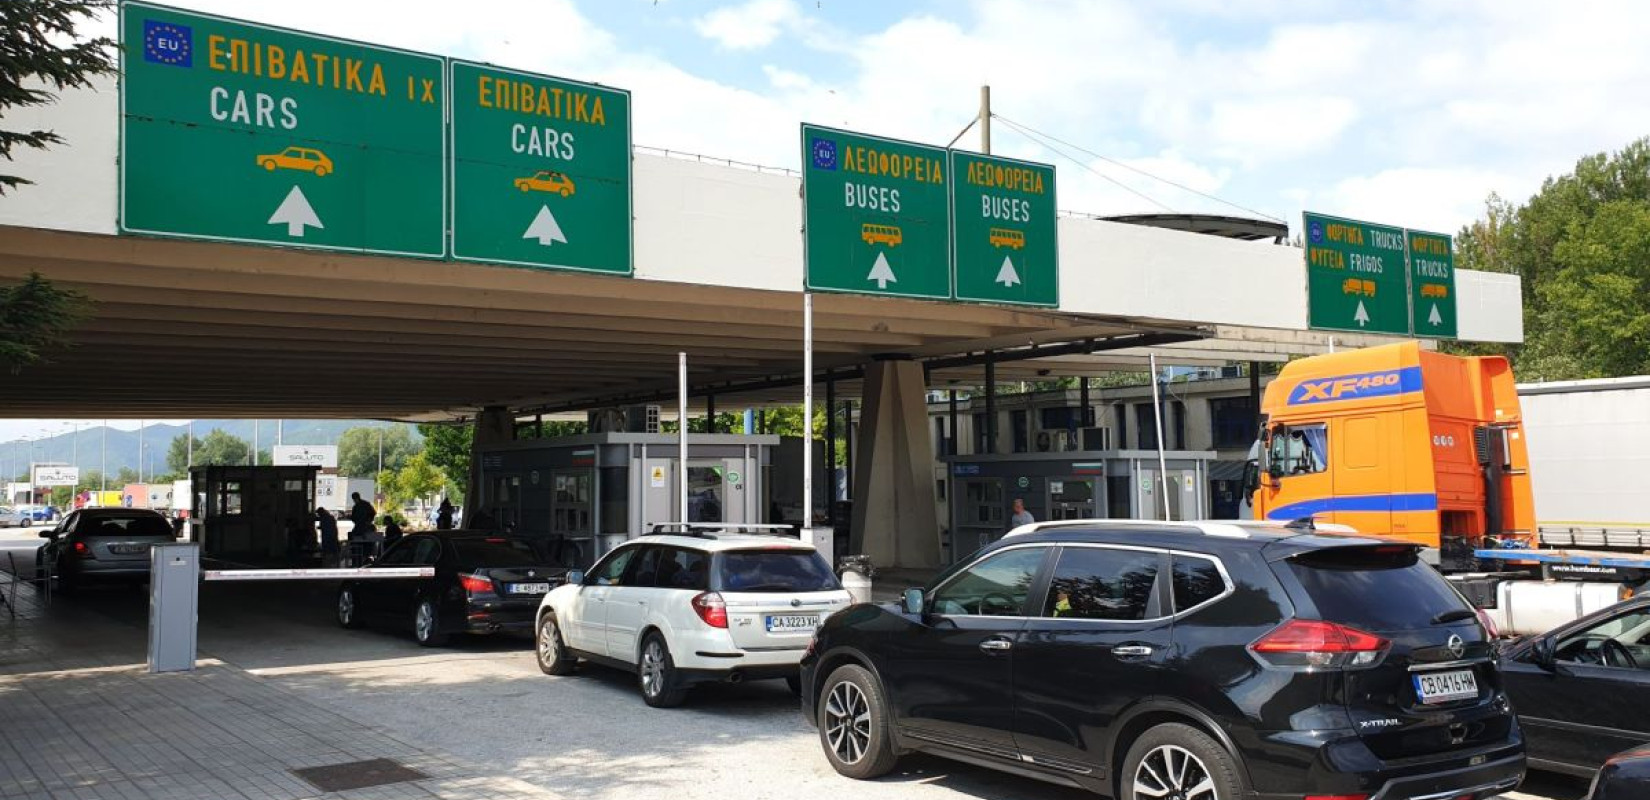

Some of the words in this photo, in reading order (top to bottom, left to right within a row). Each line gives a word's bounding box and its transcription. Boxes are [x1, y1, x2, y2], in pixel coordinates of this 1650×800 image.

[157, 37, 178, 51] EU
[208, 34, 386, 96] ΕΠΙΒΑΤΙΚΑ
[210, 85, 298, 130] CARS
[479, 75, 605, 126] ΕΠΙΒΑΤΙΚΑ
[511, 122, 575, 160] CARS
[820, 149, 830, 159] EU
[844, 145, 943, 185] ΛΕΩΦΟΡΕΙΑ
[967, 161, 1043, 194] ΛΕΩΦΟΡΕΙΑ
[845, 182, 901, 213] BUSES
[982, 194, 1030, 222] BUSES
[1370, 230, 1404, 251] TRUCKS
[1350, 253, 1383, 273] FRIGOS
[1415, 259, 1449, 279] TRUCKS
[786, 617, 806, 628] 3223
[1437, 675, 1460, 692] 0416
[1359, 718, 1403, 729] X-TRAIL
